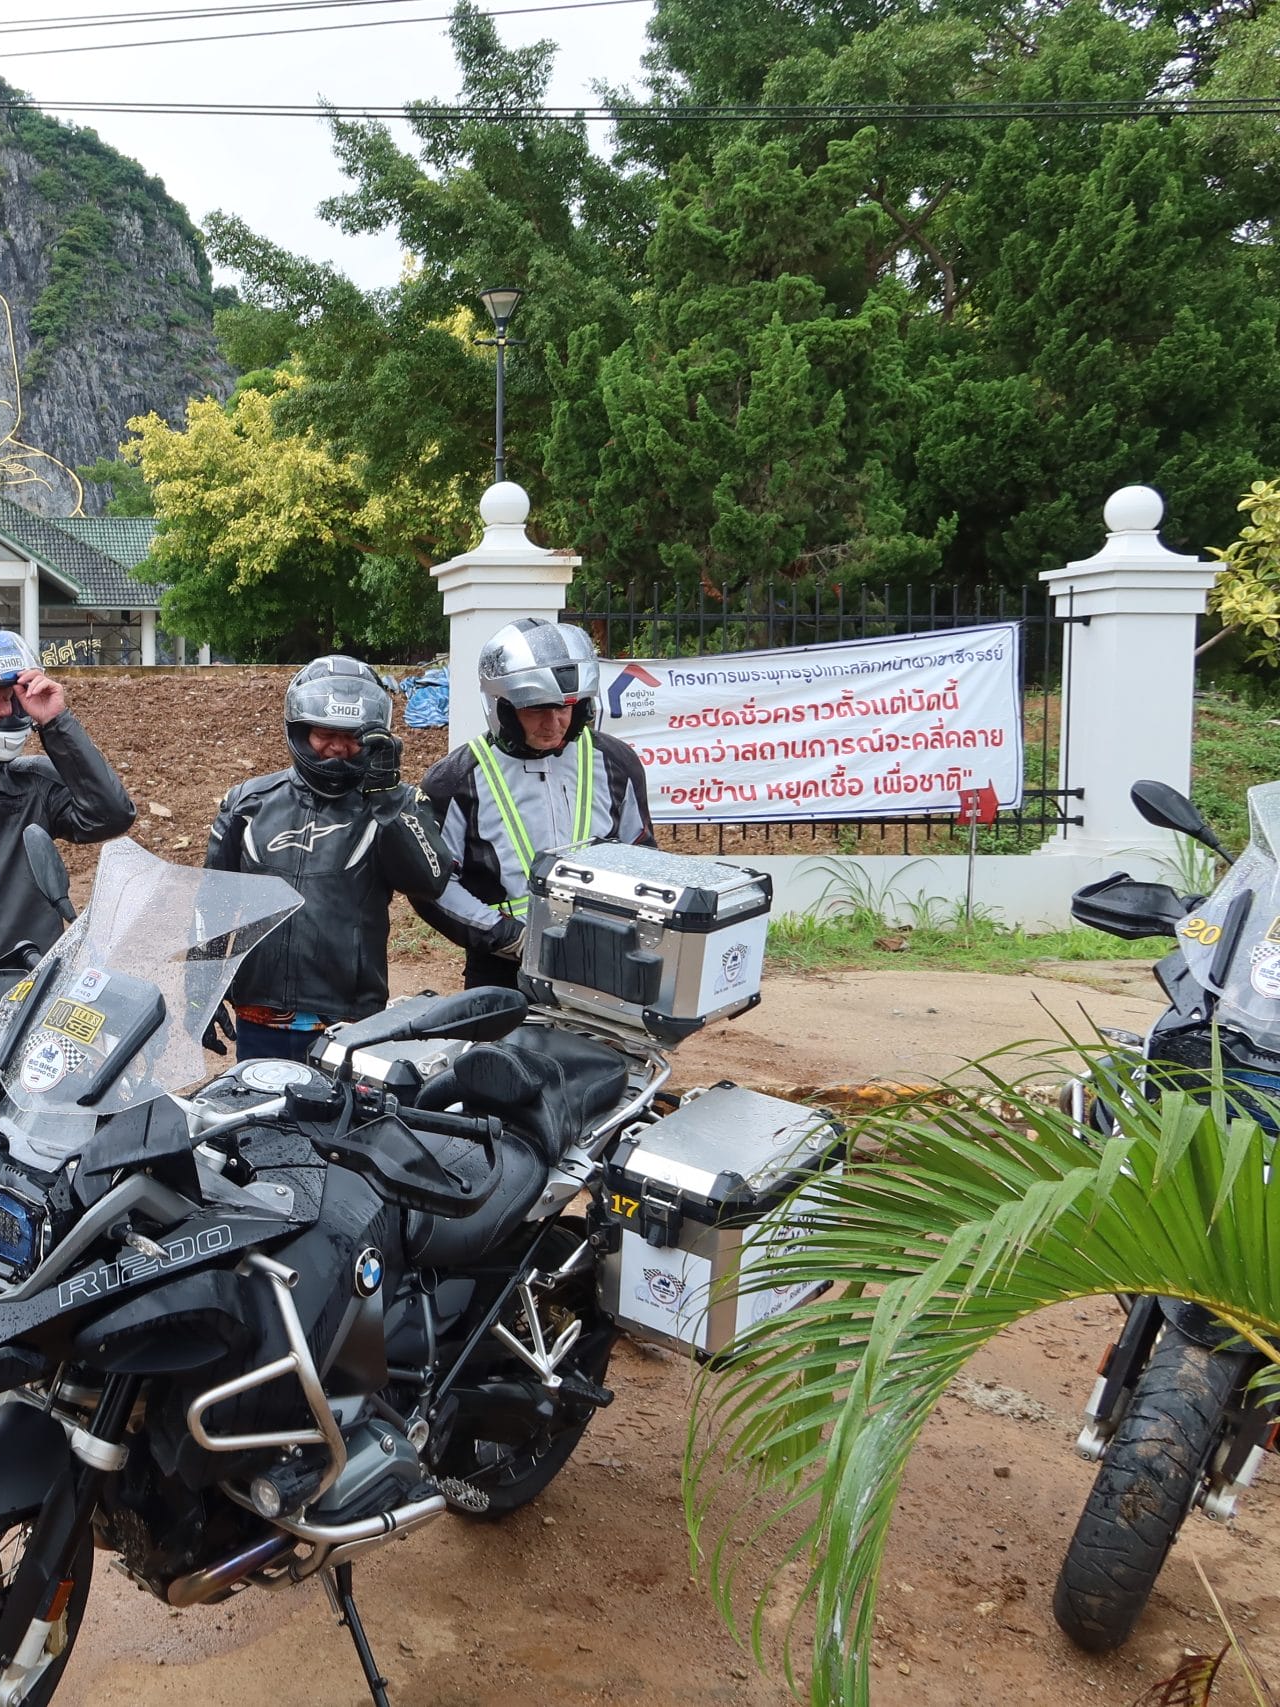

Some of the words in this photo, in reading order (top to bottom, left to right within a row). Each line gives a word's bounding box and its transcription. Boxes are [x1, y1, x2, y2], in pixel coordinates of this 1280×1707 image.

[331, 705, 360, 717] SHOEI
[668, 678, 960, 729] ขอปิดชั่วคราวตั้งแต่บัดนี้
[660, 777, 758, 811] "อยู่บ้าน
[765, 763, 864, 807] หยุดเชื้อ
[873, 761, 973, 795] เพื่อชาติ"
[1181, 918, 1222, 945] 20
[48, 1002, 73, 1028] 40
[74, 1007, 100, 1026] YEARS
[65, 1019, 94, 1038] GS
[611, 1194, 639, 1218] 17
[57, 1224, 233, 1309] R1200
